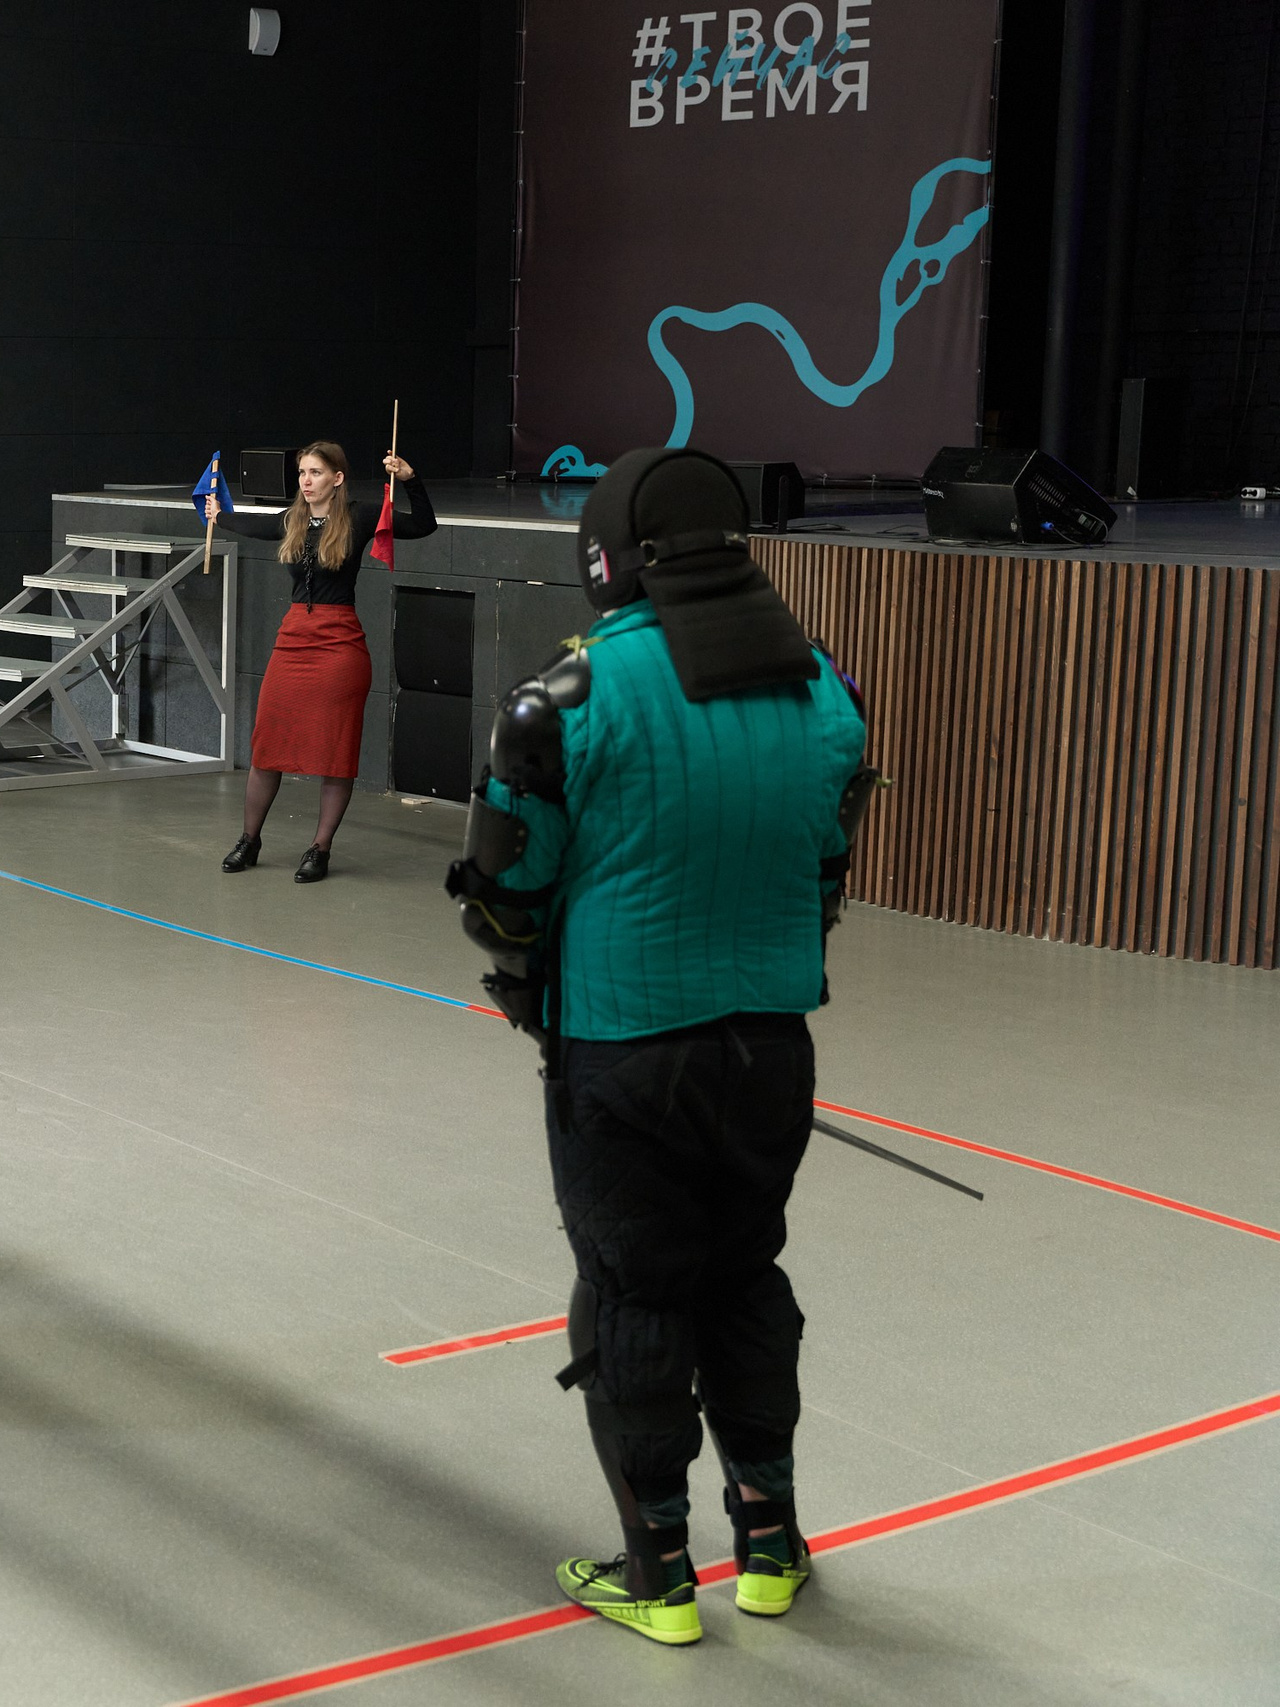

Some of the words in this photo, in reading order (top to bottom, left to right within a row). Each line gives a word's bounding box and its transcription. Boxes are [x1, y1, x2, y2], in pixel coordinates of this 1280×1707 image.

[631, 0, 871, 67] #ТВОЕ
[645, 30, 851, 93] СЕЙЧАС
[629, 60, 869, 128] ВРЕМЯ
[636, 1599, 666, 1608] SPORT
